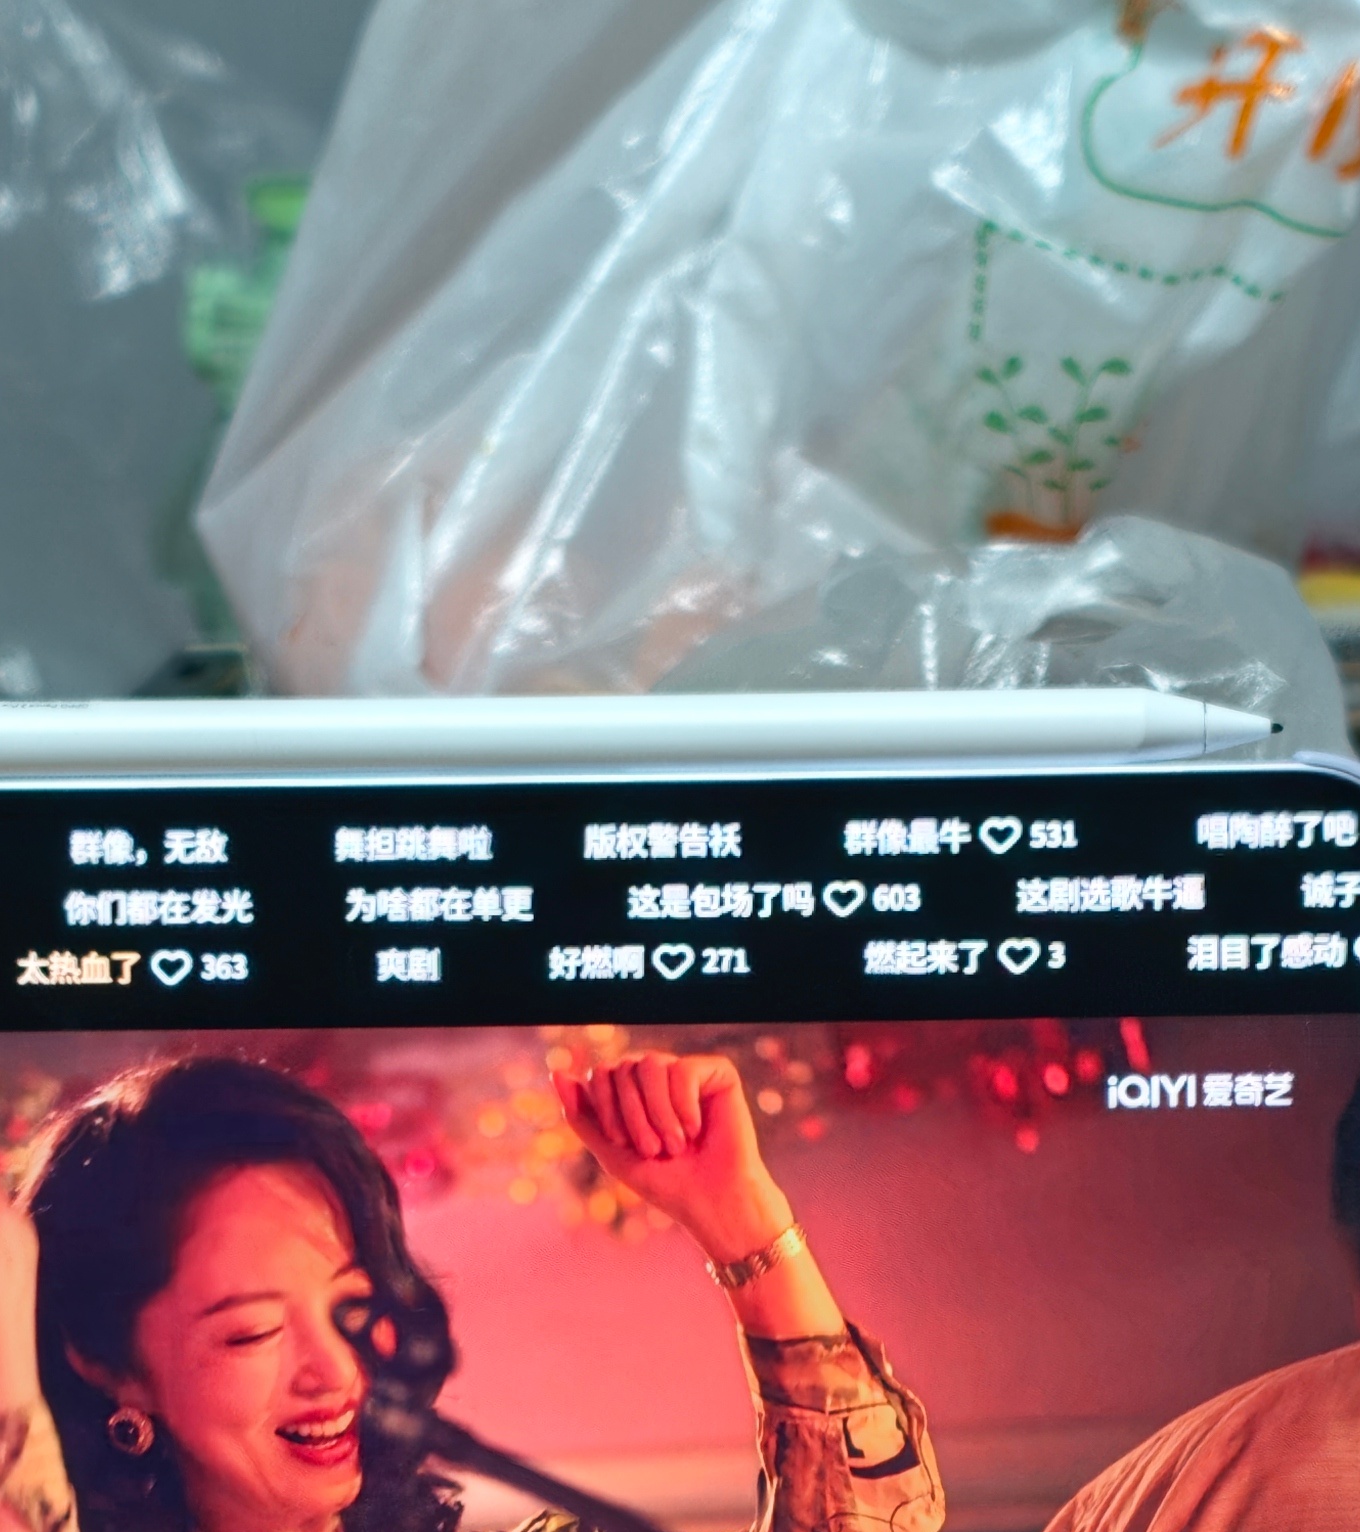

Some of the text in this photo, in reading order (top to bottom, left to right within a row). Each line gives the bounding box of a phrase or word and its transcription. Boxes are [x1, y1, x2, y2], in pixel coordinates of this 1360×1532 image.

[844, 818, 1078, 856] 群像最牛 531
[63, 888, 254, 926] 你们都在发光
[627, 882, 921, 919] 这是包场了吗 603
[17, 951, 248, 985] 太热血了 363
[376, 948, 441, 982] 爽剧
[549, 945, 750, 980] 好燃啊 271
[864, 939, 1066, 975] 燃起来了 3
[1187, 932, 1348, 971] 泪目了感动
[1107, 1072, 1294, 1109] iQIYI 爱奇艺
